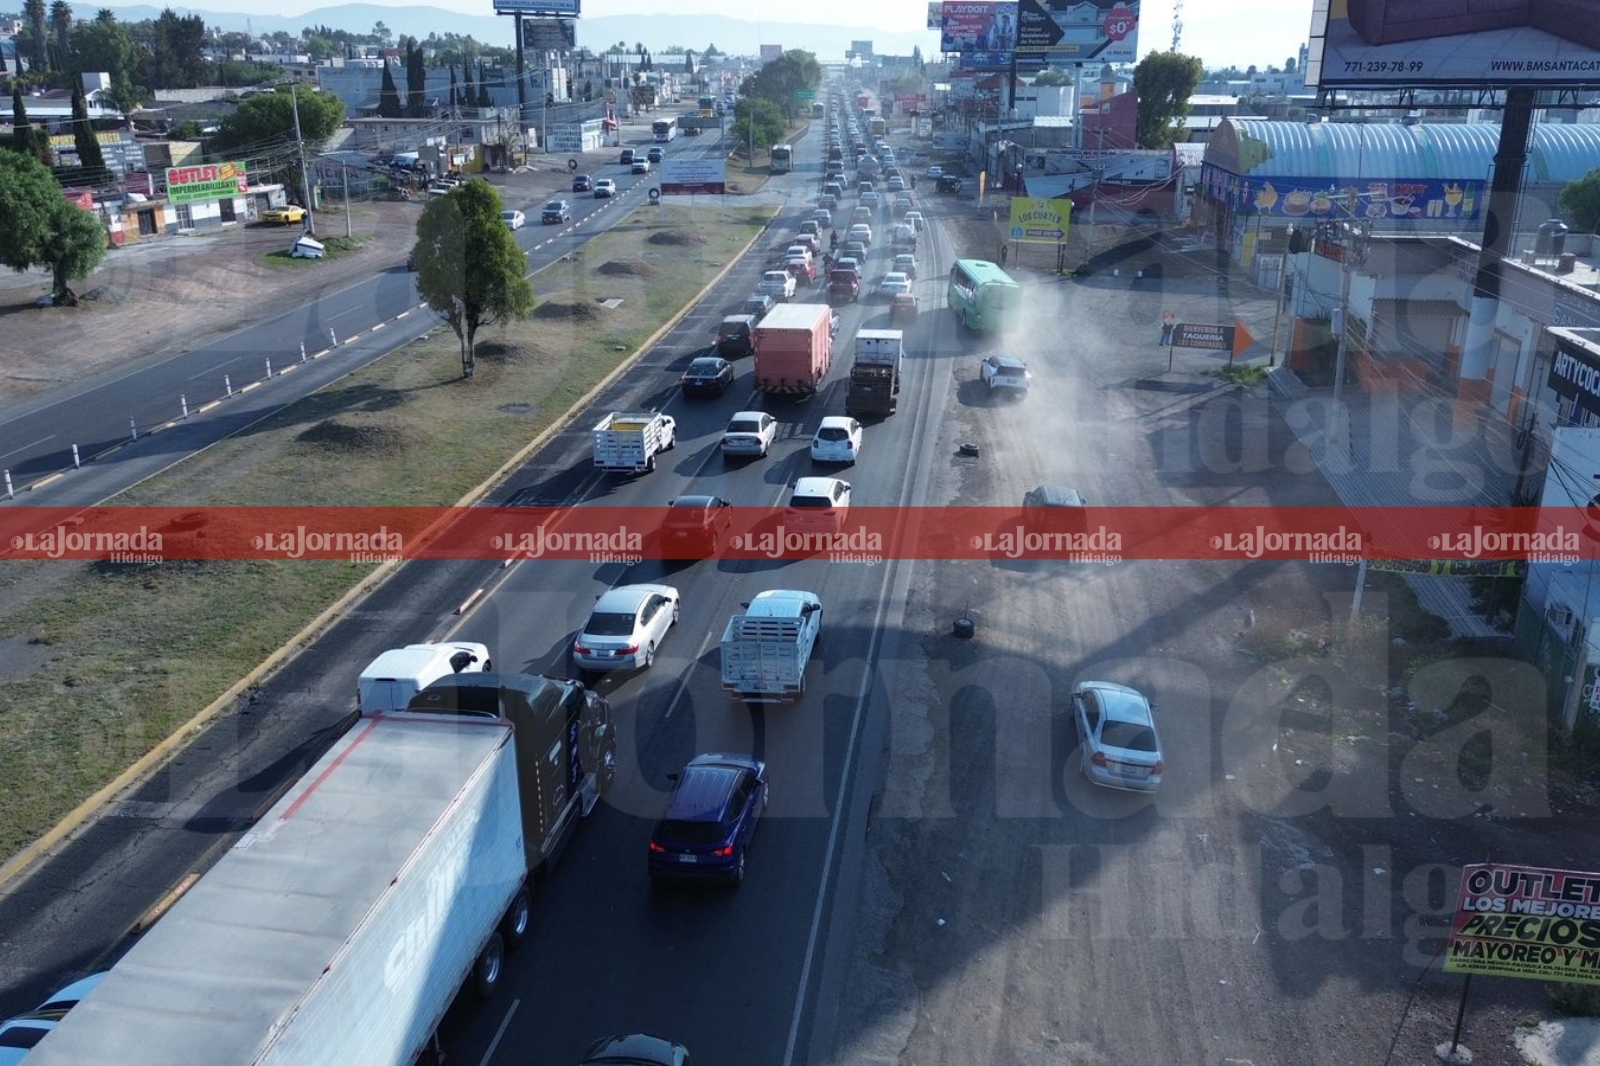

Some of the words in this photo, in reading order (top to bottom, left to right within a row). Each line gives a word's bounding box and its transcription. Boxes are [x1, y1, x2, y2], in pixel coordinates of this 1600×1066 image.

[944, 5, 988, 14] PLAYDOIT
[1344, 61, 1424, 72] 771-239-78-99
[168, 165, 218, 186] OUTLET
[1018, 211, 1031, 224] LOS
[1033, 211, 1062, 224] CUATES
[1467, 869, 1600, 904] OUTLET
[1463, 897, 1506, 912] LOS
[1459, 915, 1600, 948] PRECIOS
[1451, 939, 1558, 964] MAYOREO
[1562, 948, 1581, 967] Y
